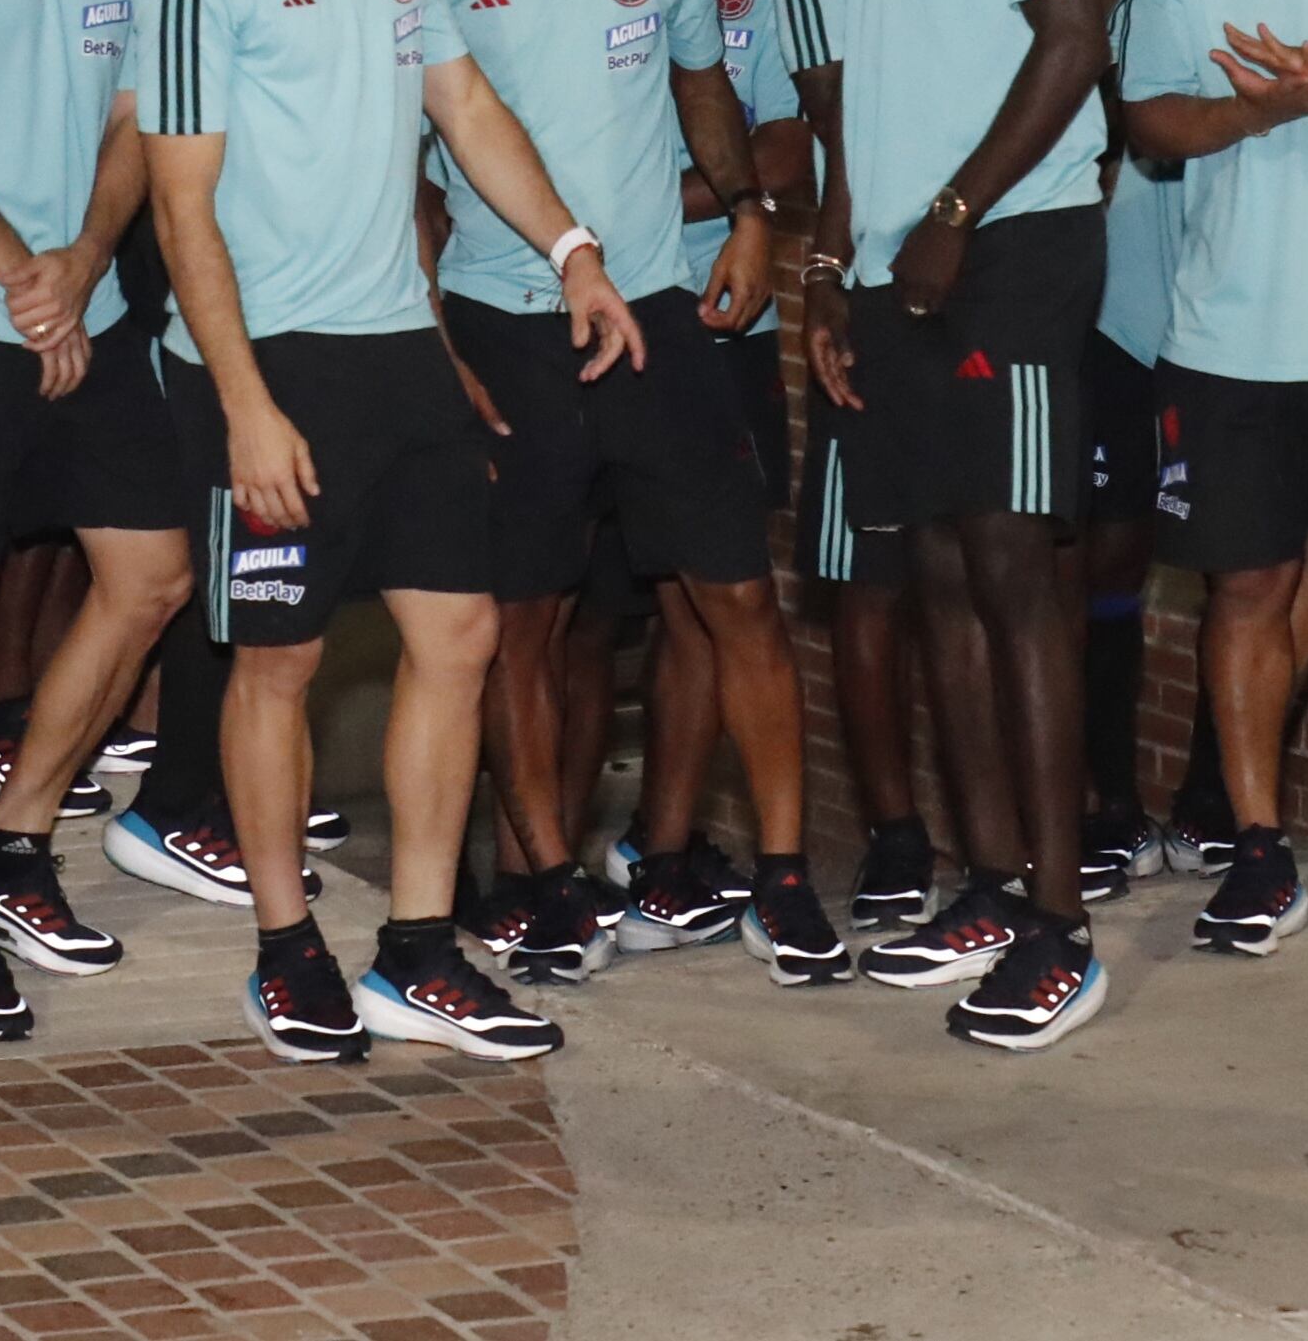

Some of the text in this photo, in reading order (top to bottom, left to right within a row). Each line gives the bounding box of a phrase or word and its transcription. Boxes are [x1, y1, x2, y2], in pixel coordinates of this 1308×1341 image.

[85, 1, 129, 27] AGUILA
[609, 15, 657, 49] AGUILA
[235, 546, 302, 575] AGUILA
[230, 579, 306, 605] BetPlay
